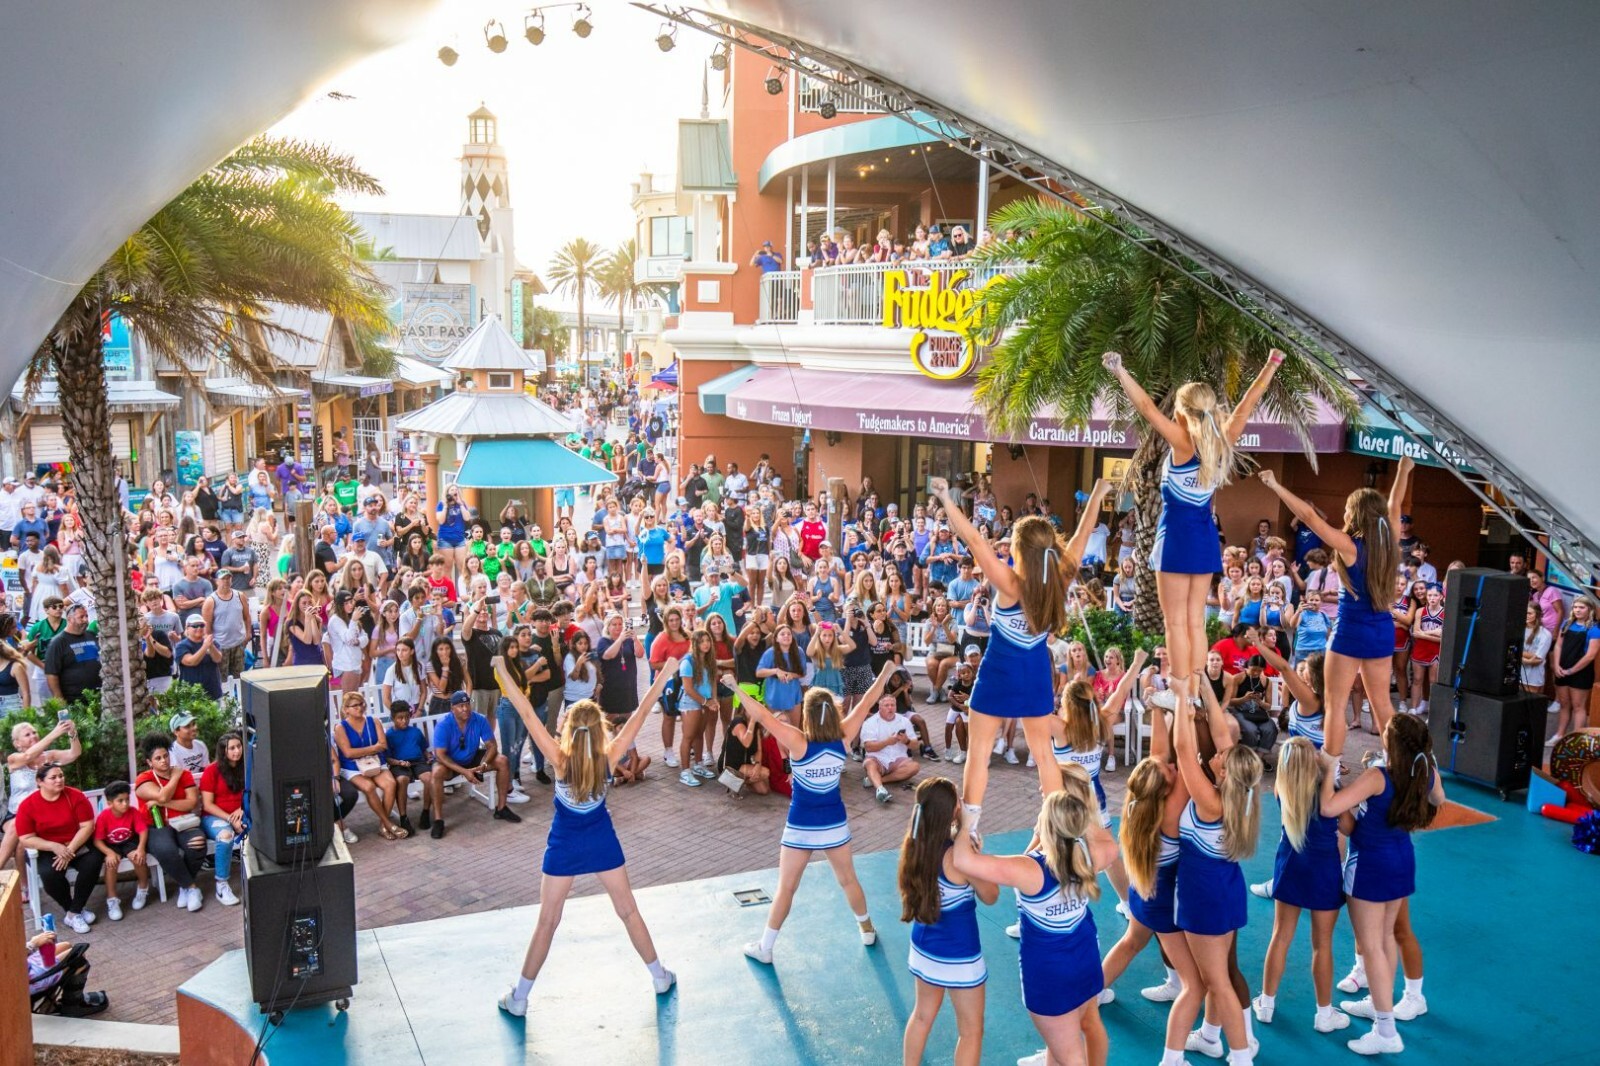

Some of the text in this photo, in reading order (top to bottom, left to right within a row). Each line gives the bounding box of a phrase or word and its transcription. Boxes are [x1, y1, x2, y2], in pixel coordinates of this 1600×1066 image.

[911, 271, 930, 287] The
[400, 325, 474, 338] EAST PASS
[772, 405, 813, 427] Frozen Yogurt
[856, 412, 915, 433] "Fudgemakers
[917, 417, 926, 432] to
[1029, 421, 1126, 447] Caramel Apples
[1234, 433, 1260, 447] eam
[1358, 431, 1390, 454] Laser
